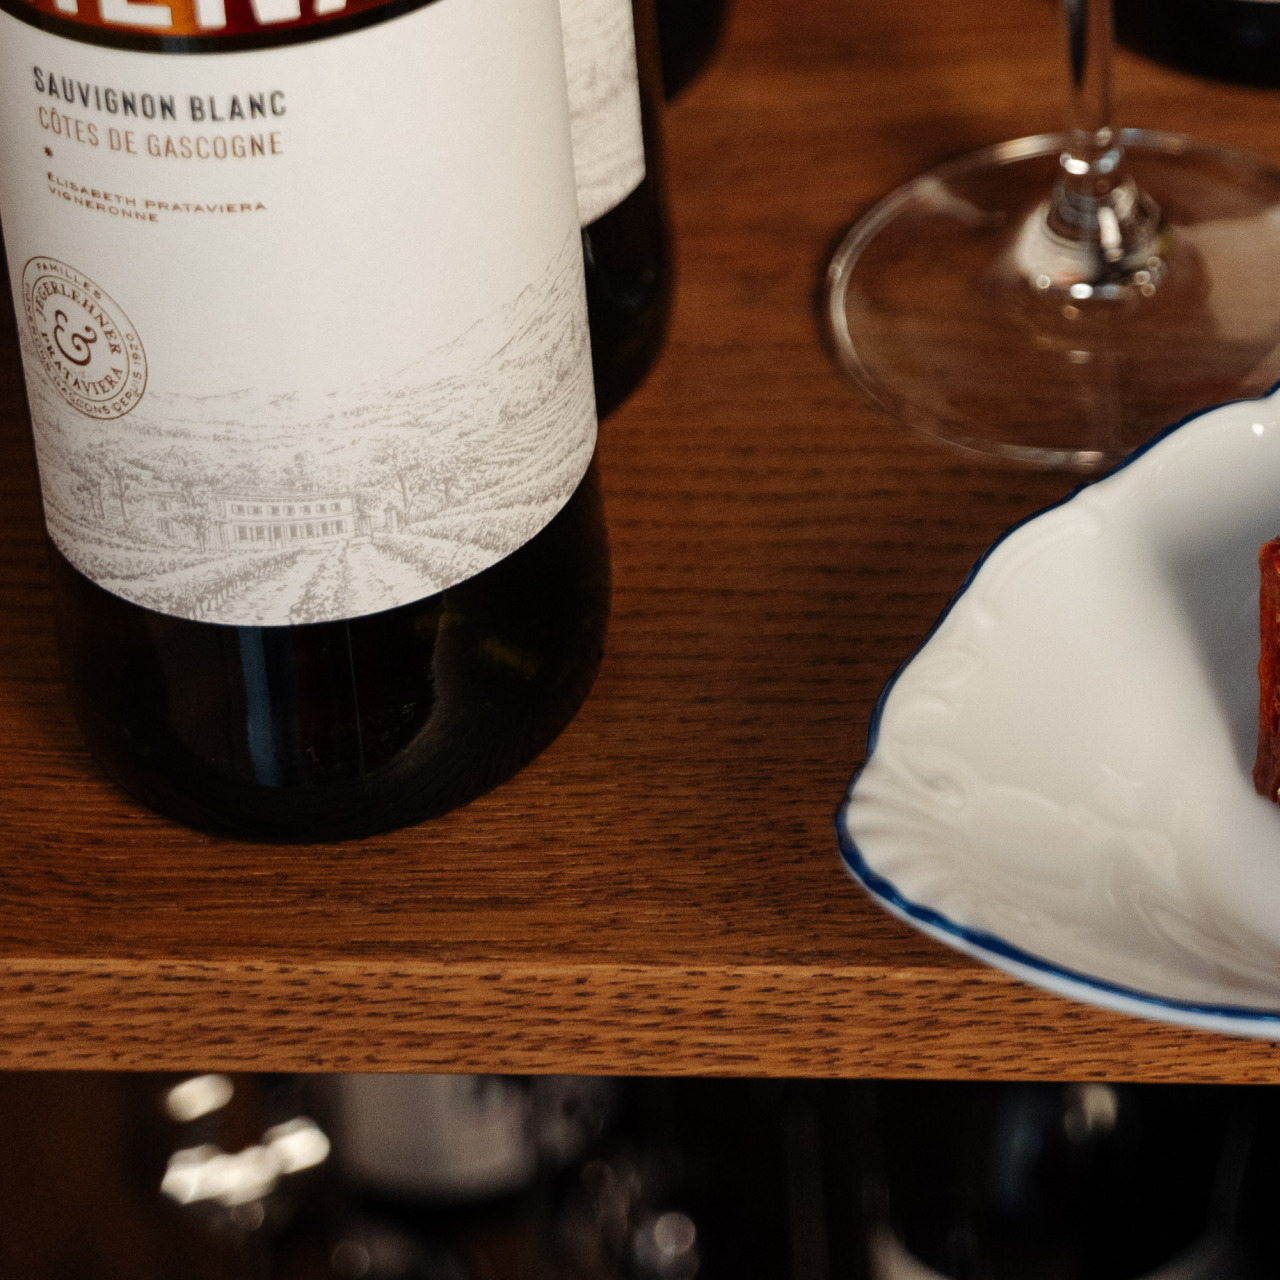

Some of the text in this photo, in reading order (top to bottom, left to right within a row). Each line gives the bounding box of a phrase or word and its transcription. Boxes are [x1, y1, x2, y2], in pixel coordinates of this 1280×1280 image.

[33, 65, 287, 122] SAUVIGNON BLANC
[38, 105, 284, 160] CÔTES DE GASCOGNE
[48, 184, 160, 224] VIGNERONNE
[145, 198, 269, 215] PRATAVIERA
